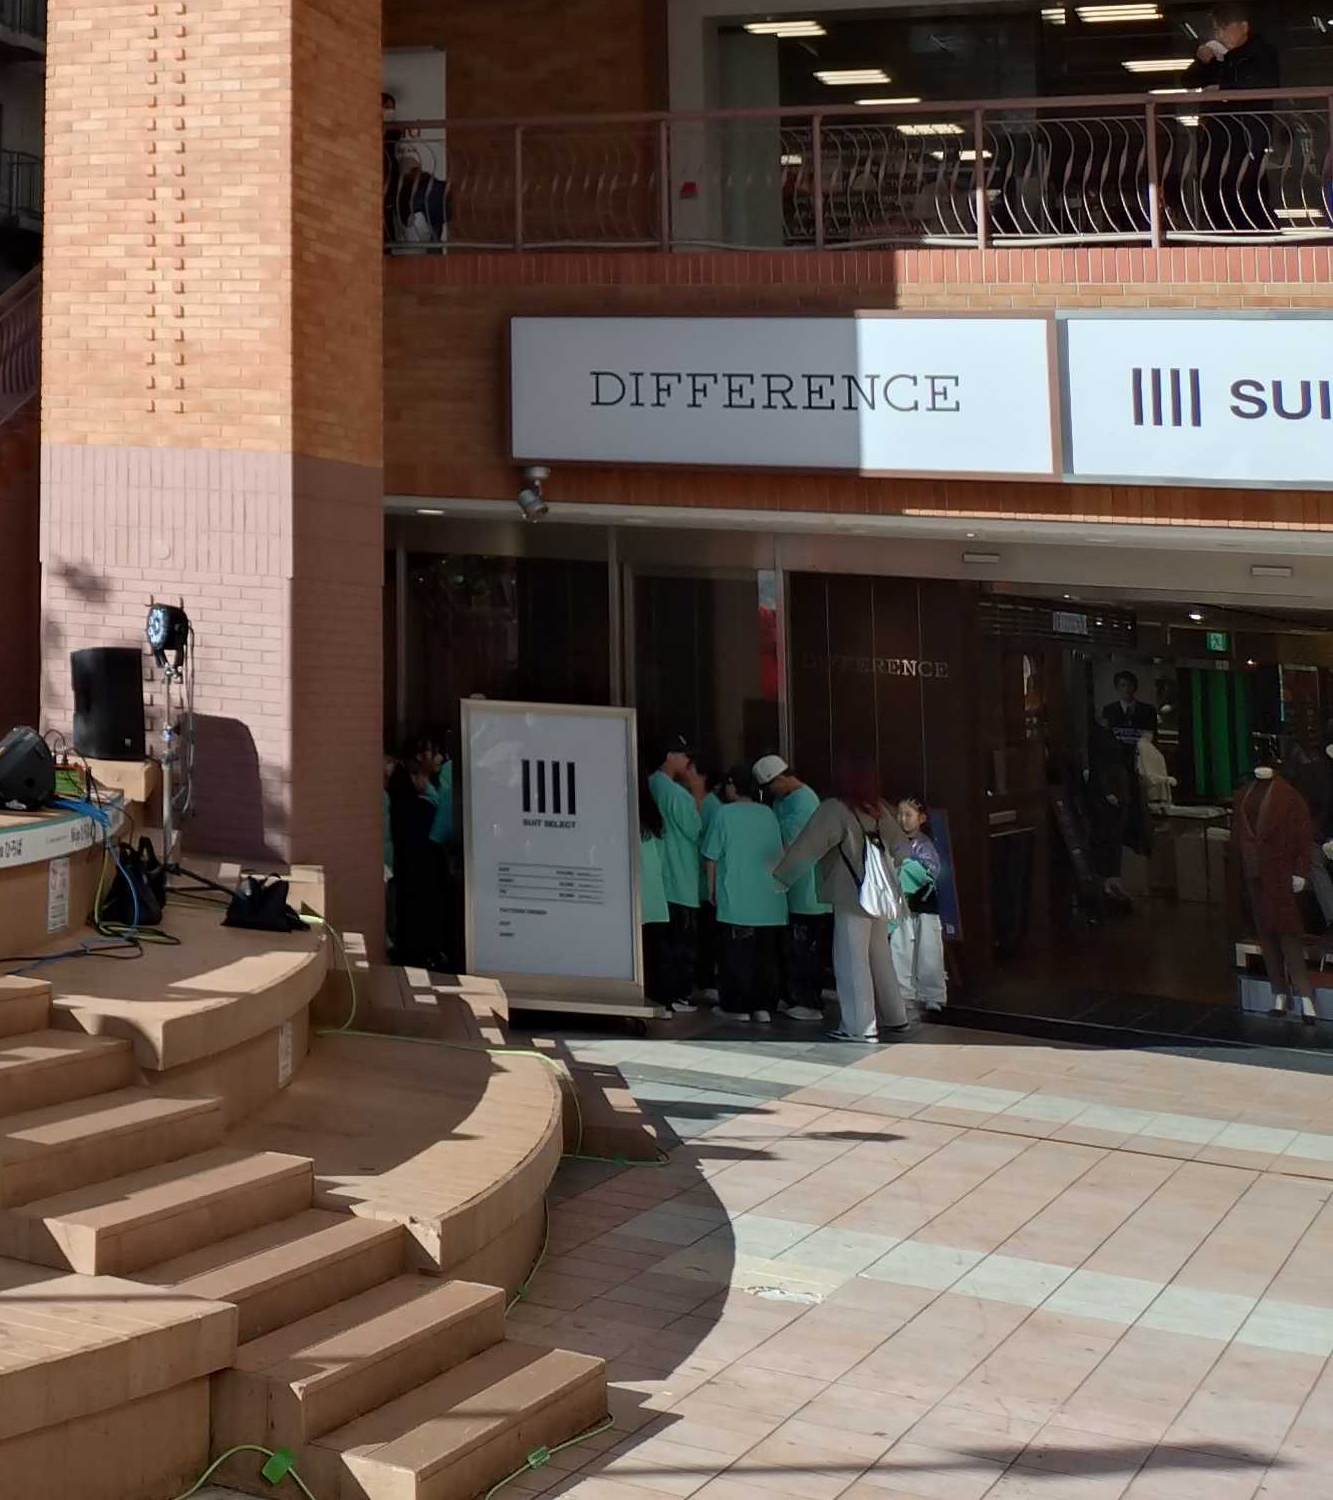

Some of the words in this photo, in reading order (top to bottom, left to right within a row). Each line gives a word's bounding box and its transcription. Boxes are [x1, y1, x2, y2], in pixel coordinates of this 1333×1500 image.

[589, 370, 962, 413] DIFFERENCE
[523, 818, 542, 827] SUIT
[544, 820, 577, 829] SELECT
